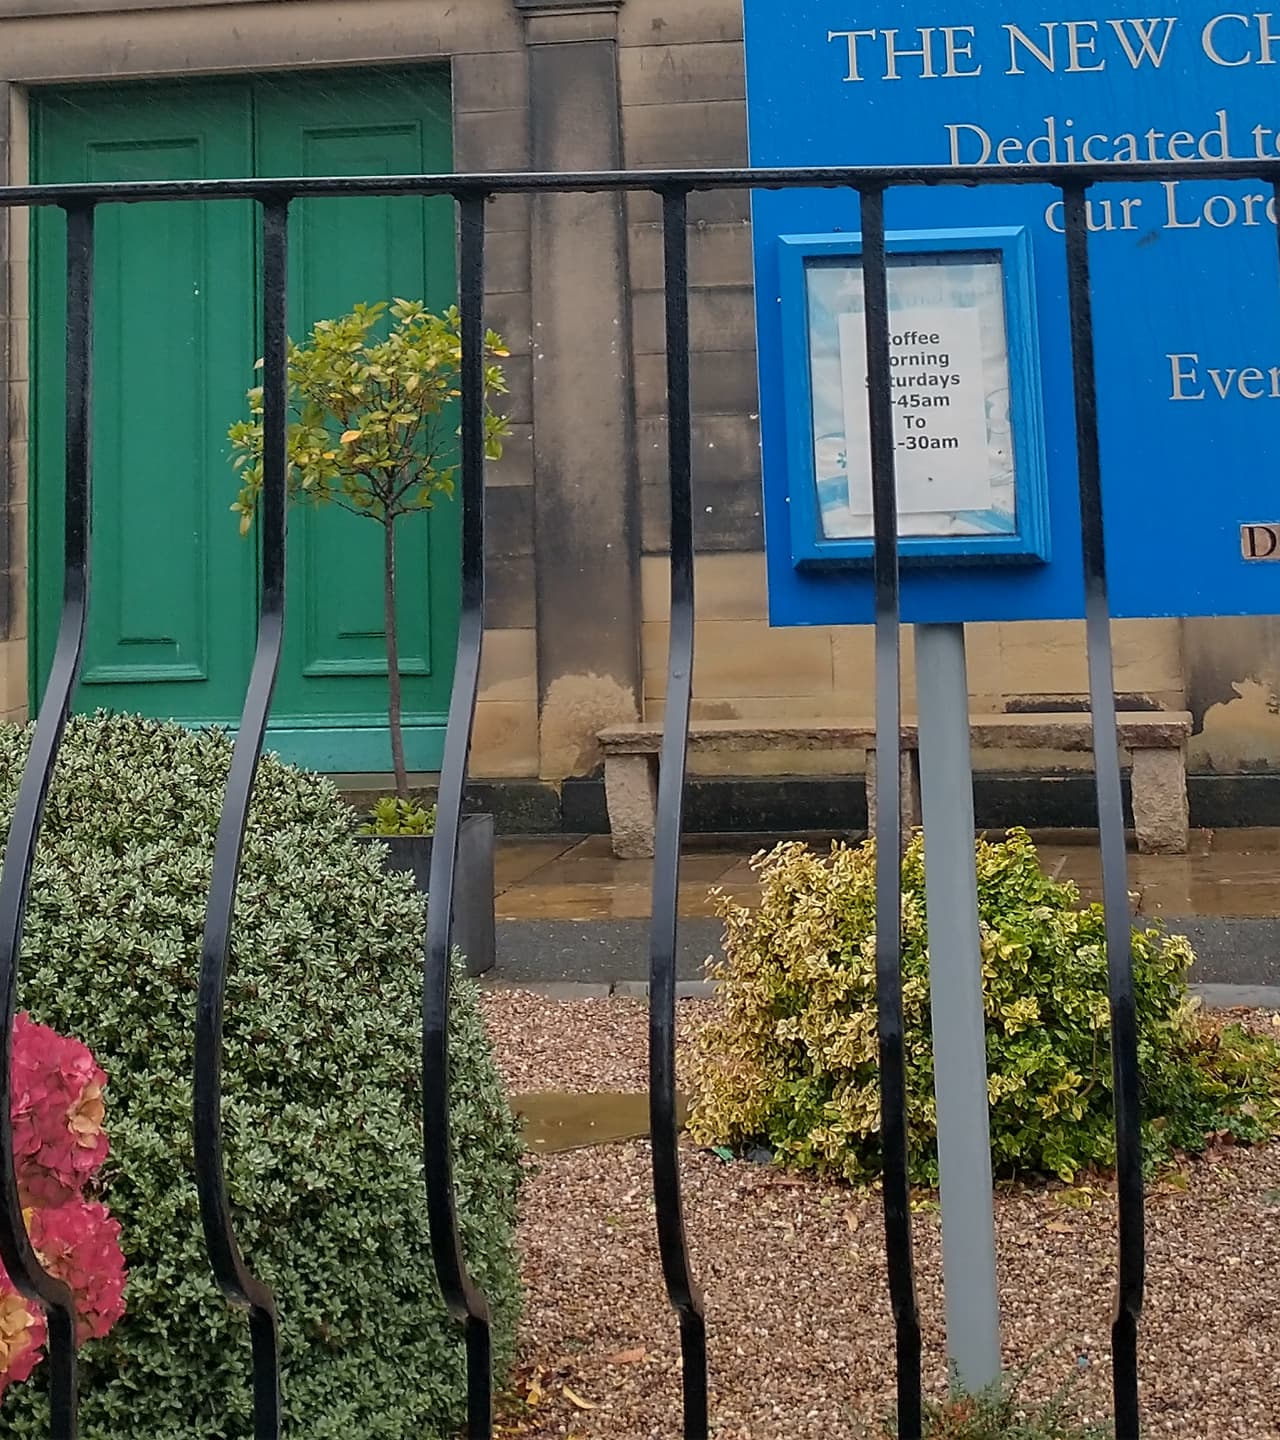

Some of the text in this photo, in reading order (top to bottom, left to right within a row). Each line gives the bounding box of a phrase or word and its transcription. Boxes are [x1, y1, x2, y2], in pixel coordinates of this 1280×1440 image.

[826, 25, 983, 82] THE
[1002, 16, 1179, 75] NEW
[944, 109, 1231, 166] Dedicated
[886, 330, 940, 347] offee
[886, 351, 950, 368] orning
[865, 371, 961, 389] turdays
[888, 393, 950, 408] -45am
[903, 414, 927, 429] To
